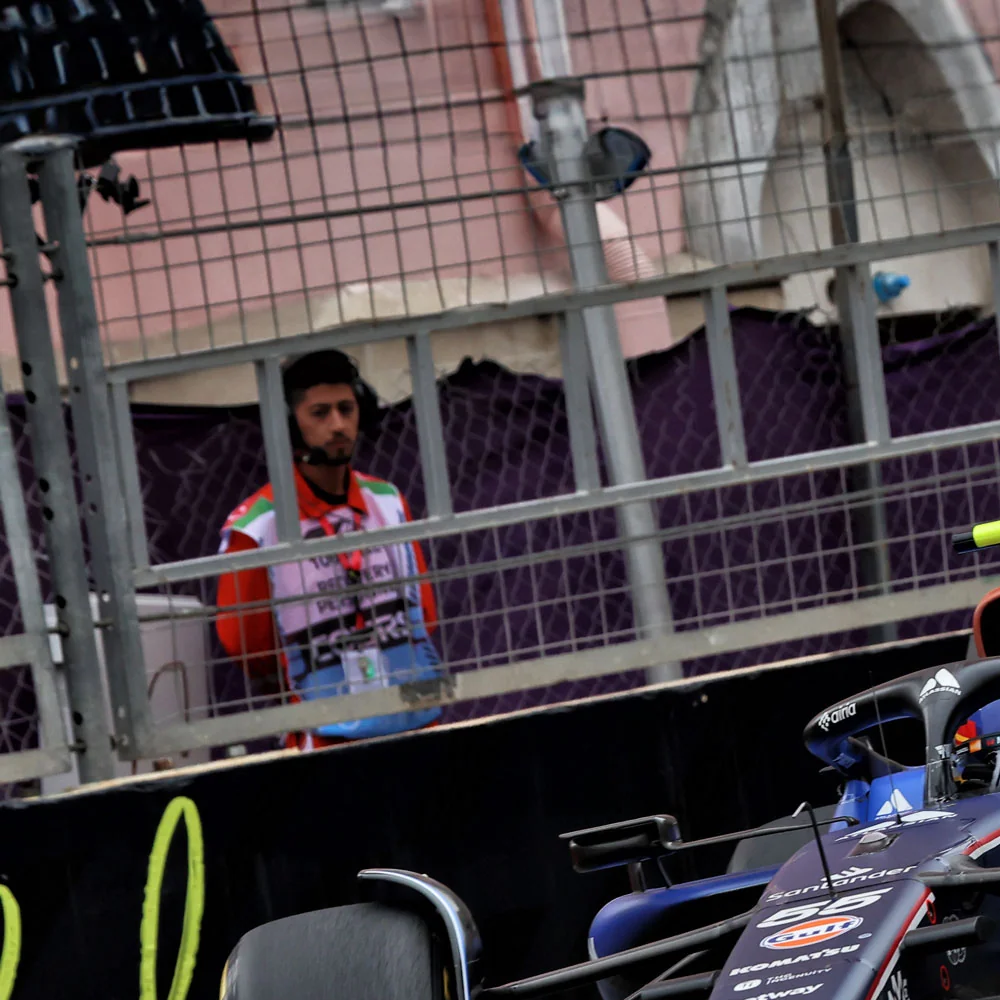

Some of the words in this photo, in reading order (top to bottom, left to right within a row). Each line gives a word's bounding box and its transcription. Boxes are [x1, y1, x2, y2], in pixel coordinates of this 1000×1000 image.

[830, 702, 857, 724] airia
[766, 864, 918, 903] Santander
[756, 886, 894, 929] 55
[767, 920, 856, 945] Gulf
[729, 943, 860, 977] KOMATSU
